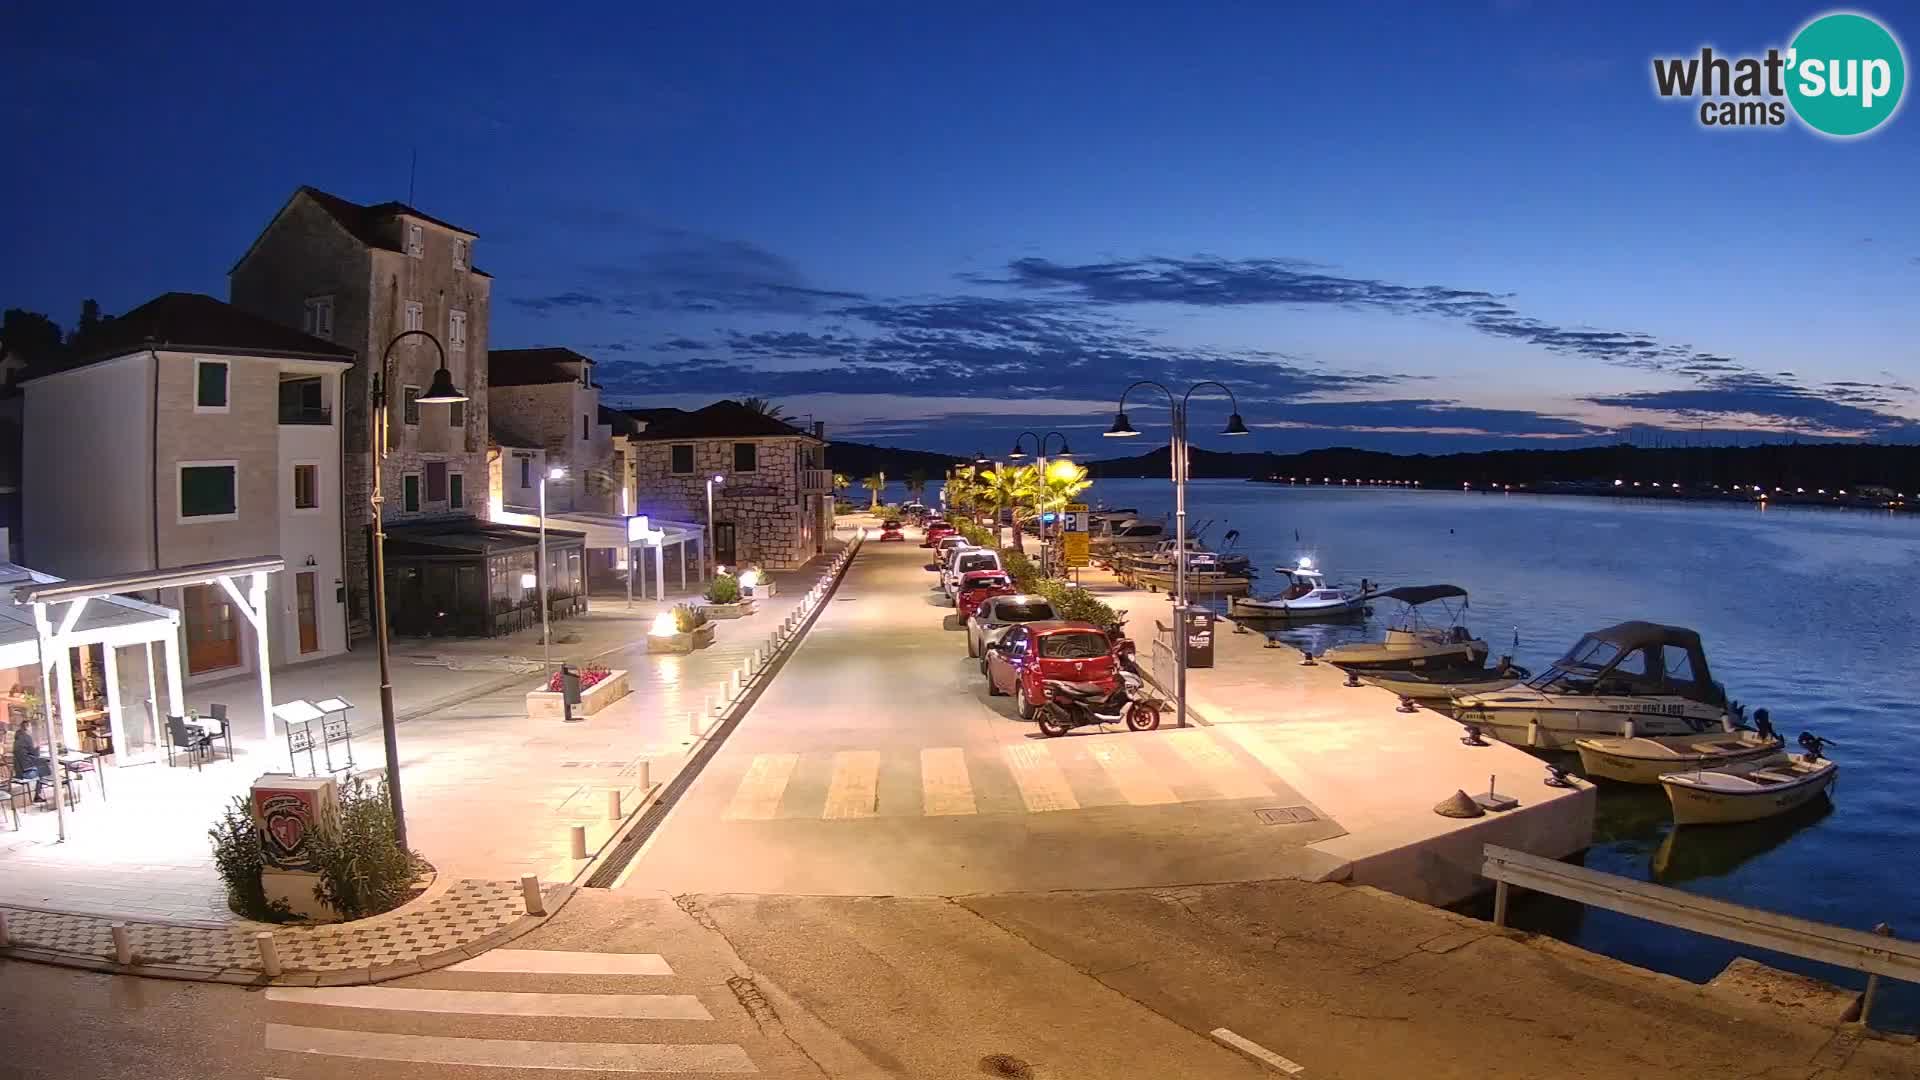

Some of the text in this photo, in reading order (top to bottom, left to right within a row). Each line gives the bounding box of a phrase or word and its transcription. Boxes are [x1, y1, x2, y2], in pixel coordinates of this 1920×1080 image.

[1065, 514, 1076, 531] P
[1643, 703, 1660, 713] RENT
[1668, 704, 1685, 715] BOAT
